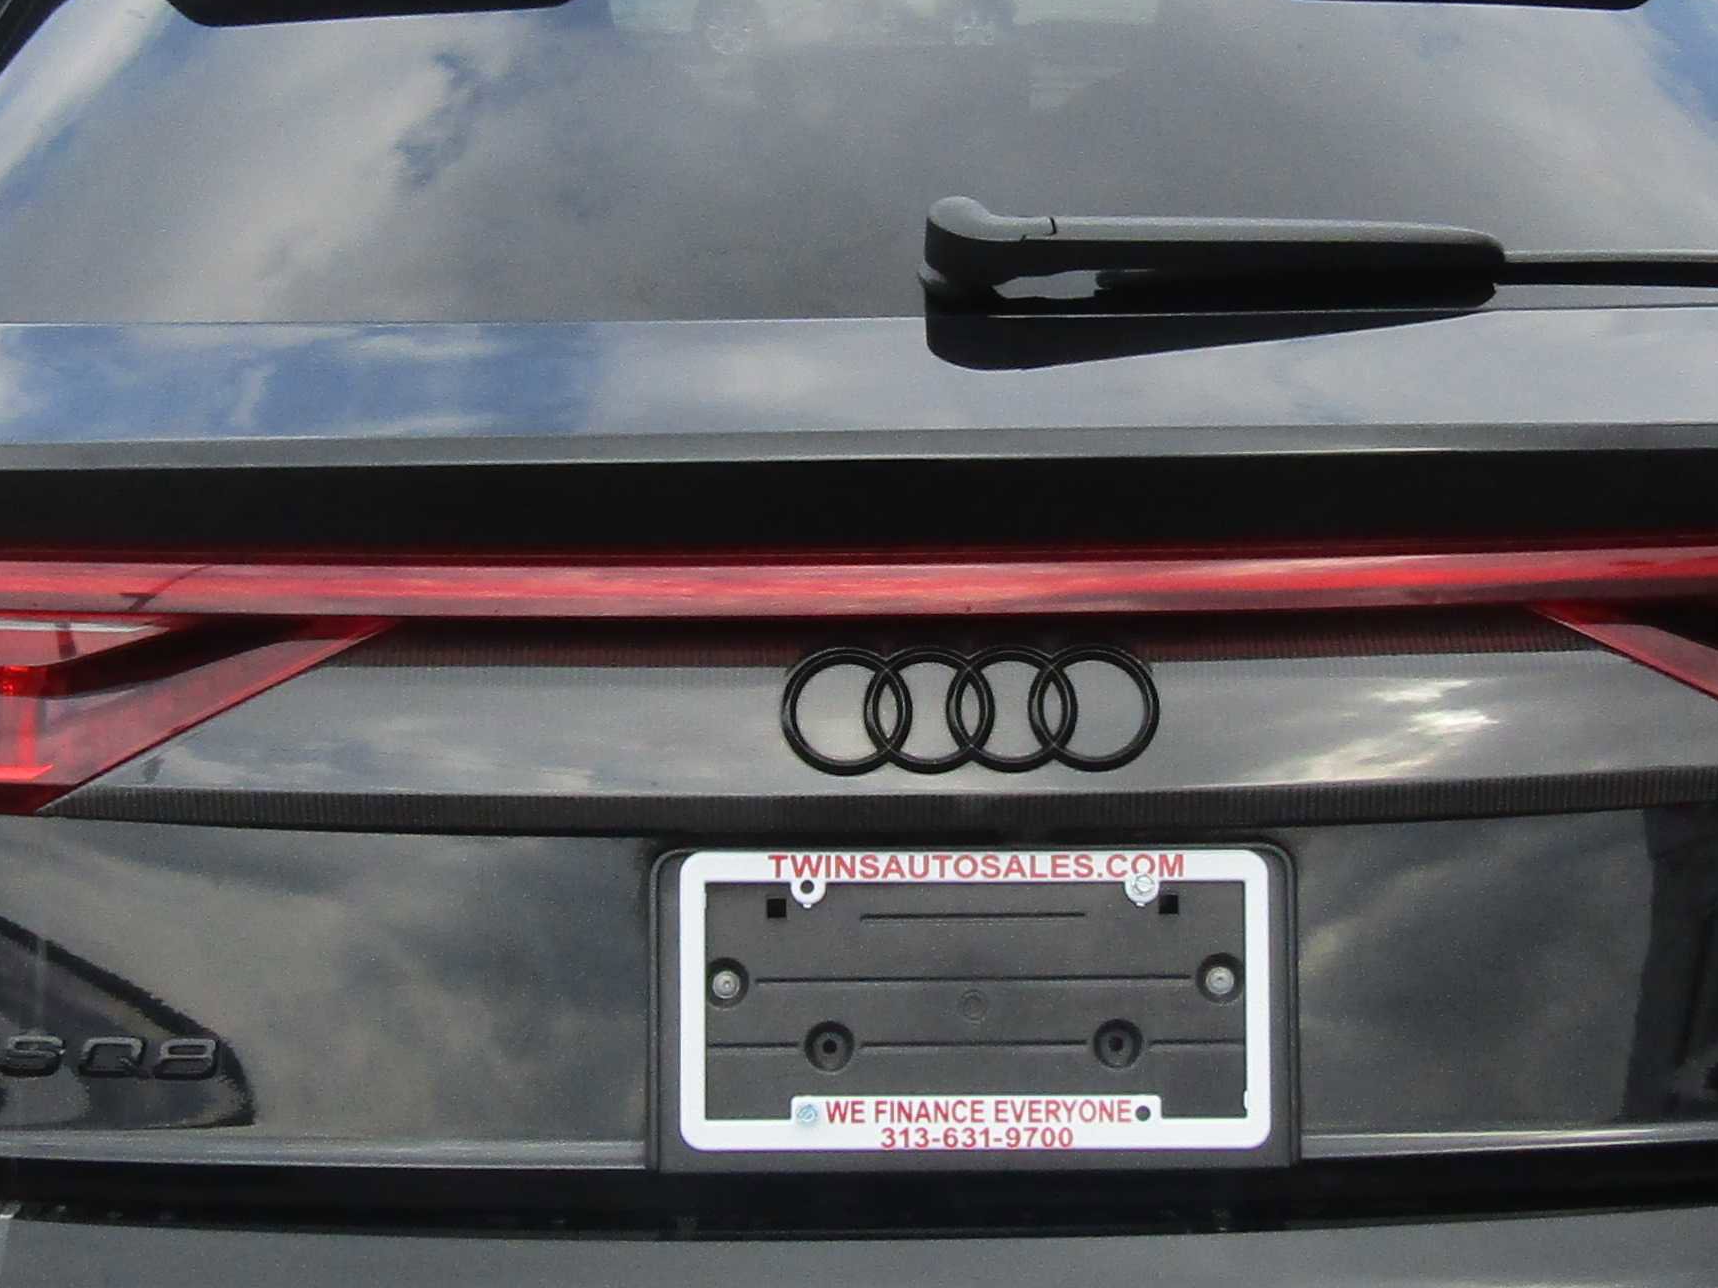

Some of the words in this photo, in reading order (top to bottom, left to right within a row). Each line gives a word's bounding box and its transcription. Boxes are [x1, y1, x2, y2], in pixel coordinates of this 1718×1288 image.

[768, 853, 1185, 881] TWINSAUTOSALES.COM
[825, 1099, 865, 1124] WE
[874, 1099, 985, 1124] FINANCE
[994, 1099, 1132, 1123] EVERYONE
[880, 1126, 1074, 1150] 313-631-9700
